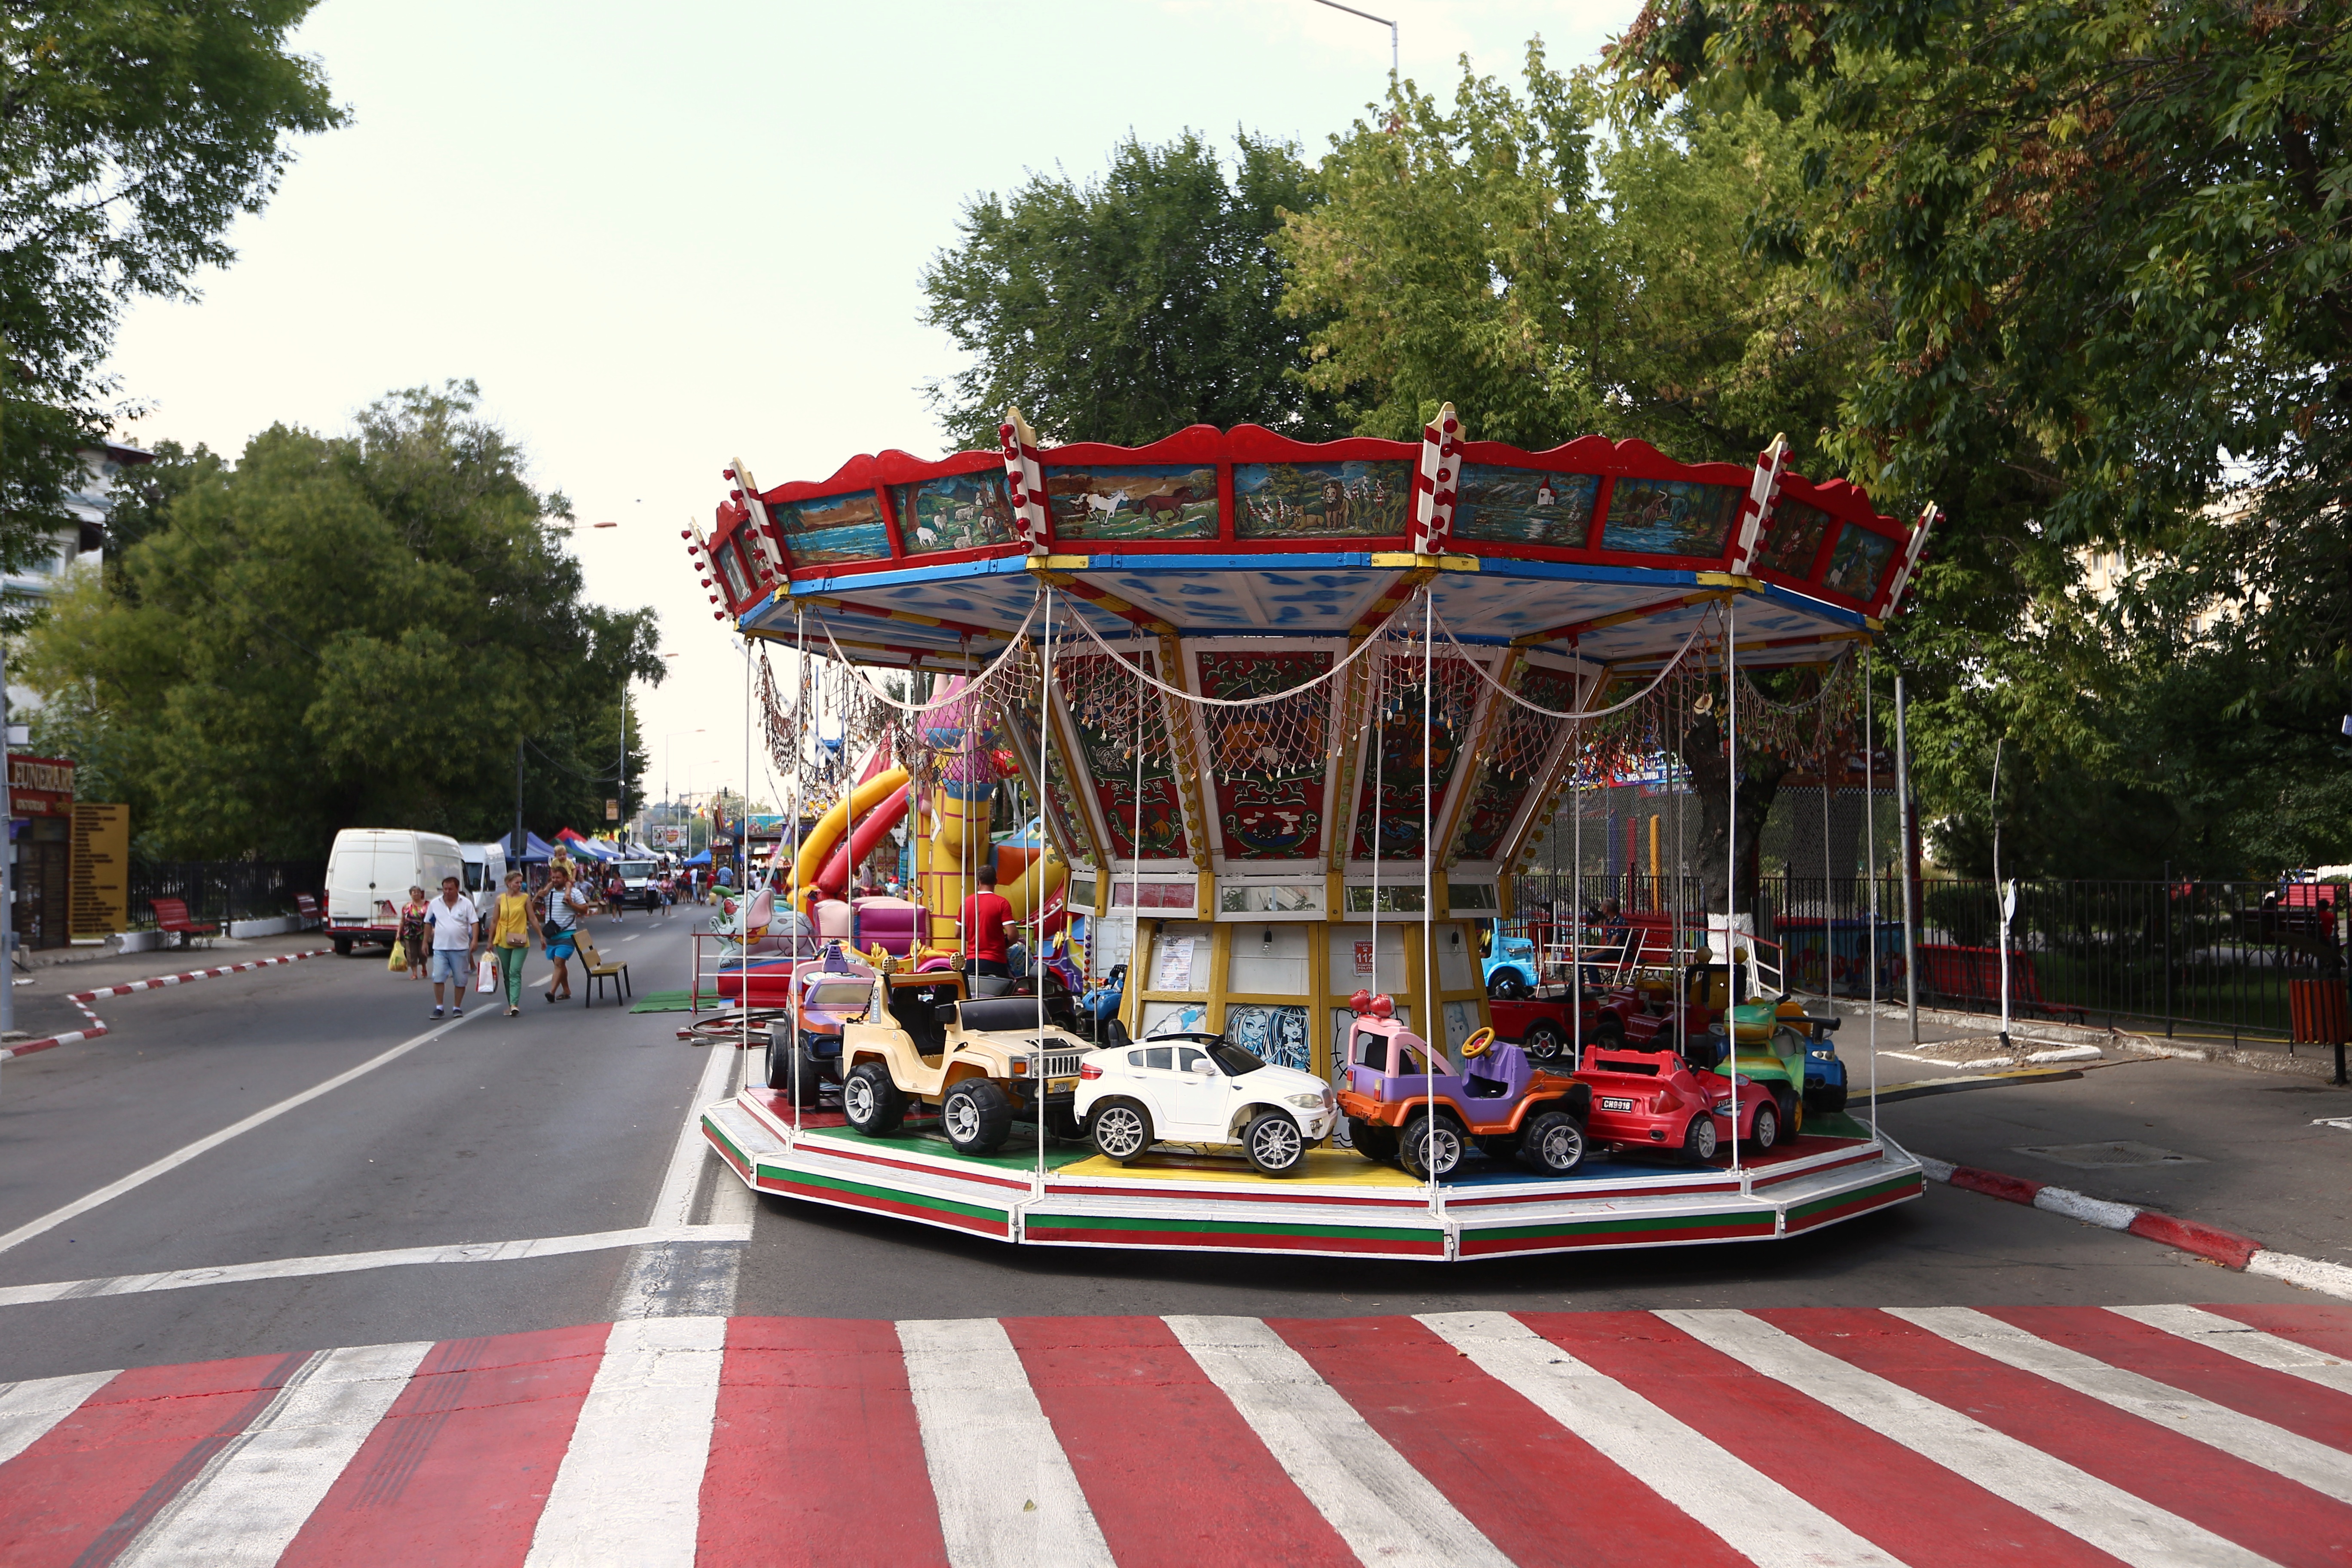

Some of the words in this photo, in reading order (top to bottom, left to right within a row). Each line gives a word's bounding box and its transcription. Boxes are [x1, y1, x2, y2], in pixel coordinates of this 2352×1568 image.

[1357, 953, 1373, 963] 112
[1603, 1100, 1631, 1110] CH9918
[1716, 1098, 1733, 1108] SUPE
